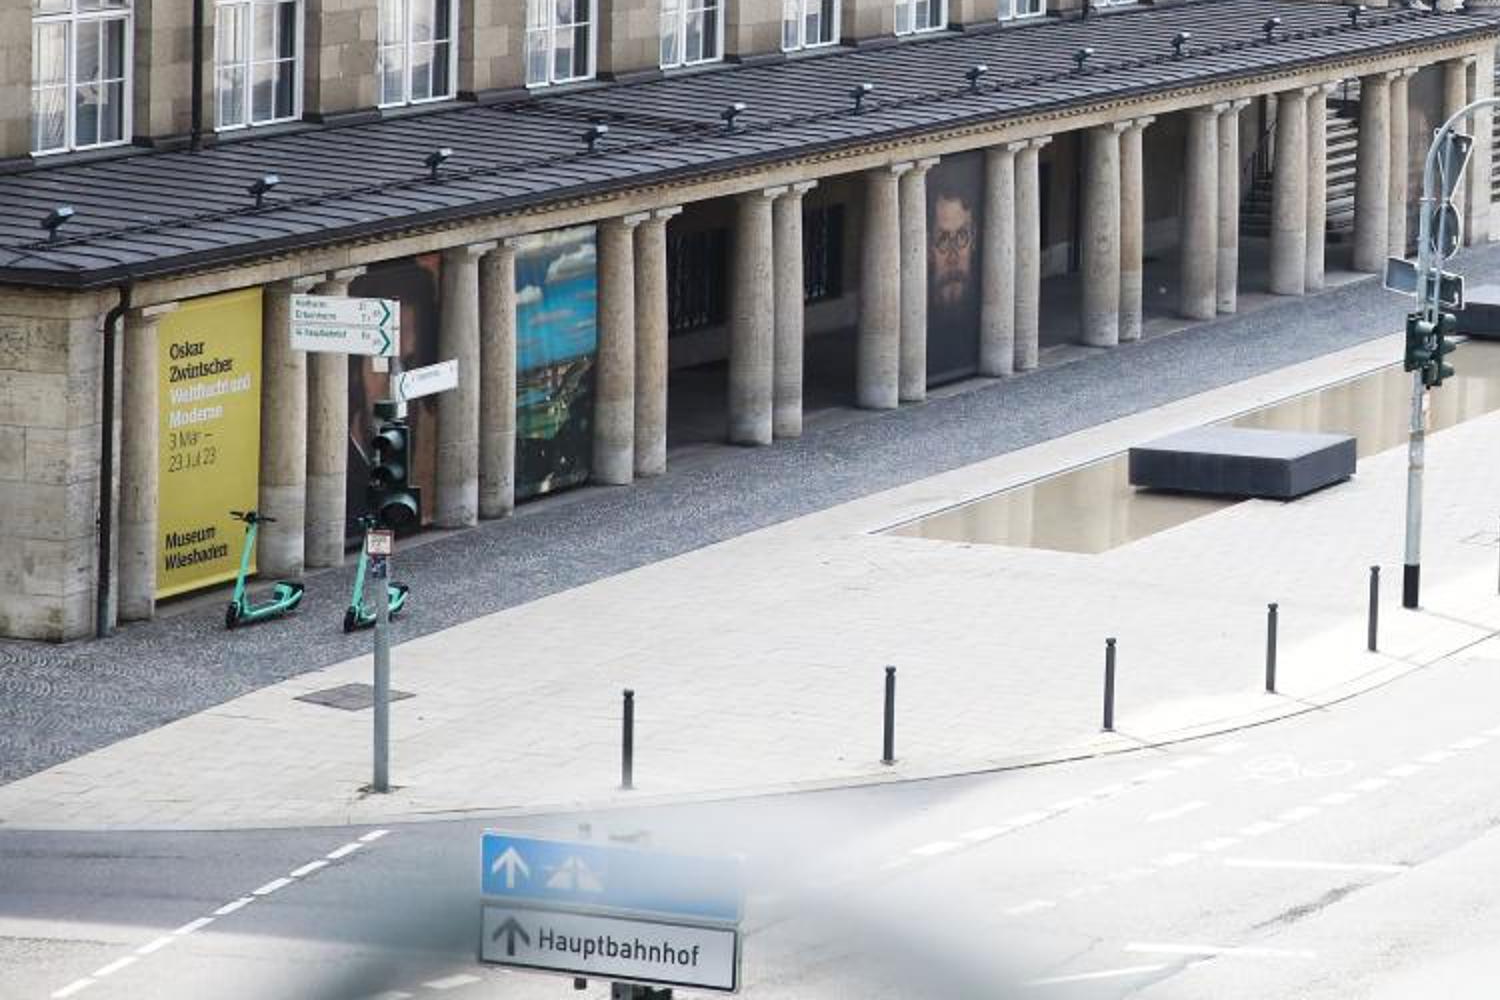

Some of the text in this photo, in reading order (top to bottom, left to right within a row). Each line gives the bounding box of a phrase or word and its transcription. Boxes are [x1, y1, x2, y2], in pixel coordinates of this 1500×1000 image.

[169, 341, 205, 360] Oskar
[168, 405, 224, 429] Moderne
[168, 433, 177, 451] 3
[165, 525, 217, 551] Museum
[164, 542, 228, 571] Wiesbaden
[538, 926, 700, 967] Hauptbahnhof
